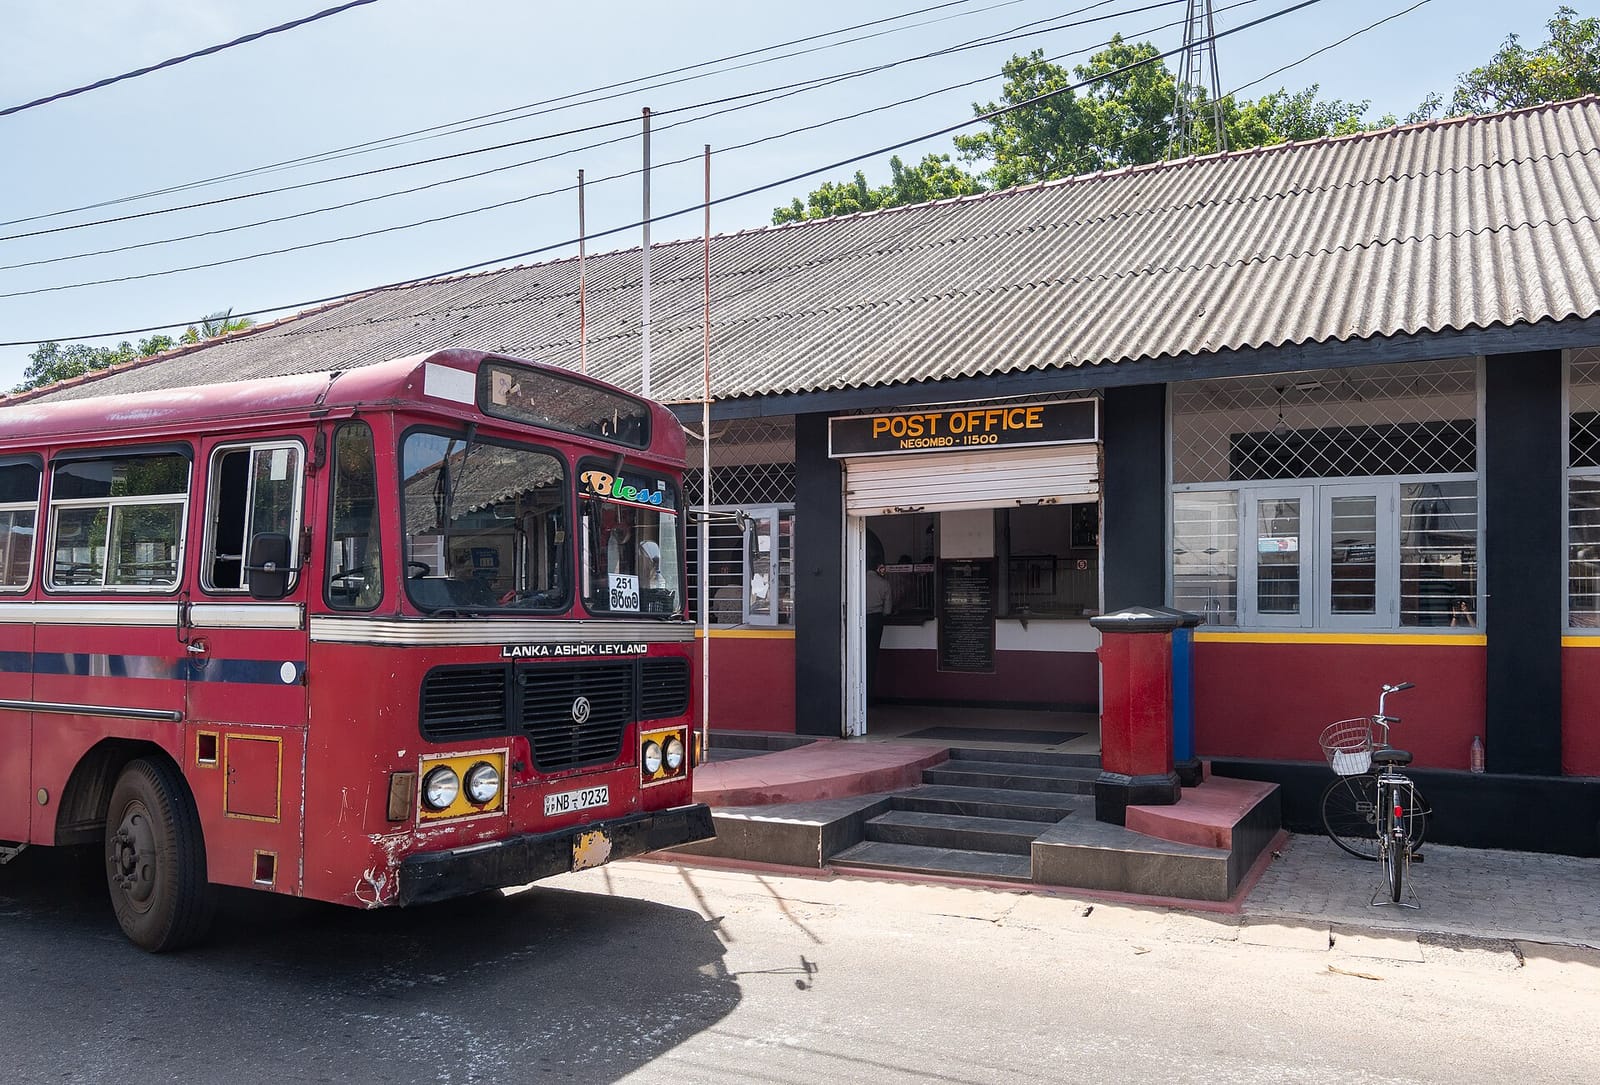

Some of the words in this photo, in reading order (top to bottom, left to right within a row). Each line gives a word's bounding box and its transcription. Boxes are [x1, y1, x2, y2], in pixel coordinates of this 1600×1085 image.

[872, 413, 942, 439] POST
[949, 406, 1045, 434] OFFICE
[900, 436, 953, 449] NEGOMBO
[963, 434, 998, 445] 11500
[580, 470, 663, 505] Bless
[616, 577, 632, 589] 251
[502, 645, 549, 657] LANKA
[554, 644, 595, 656] ASHOK
[599, 643, 648, 654] LEYLAND
[581, 788, 608, 807] 9232
